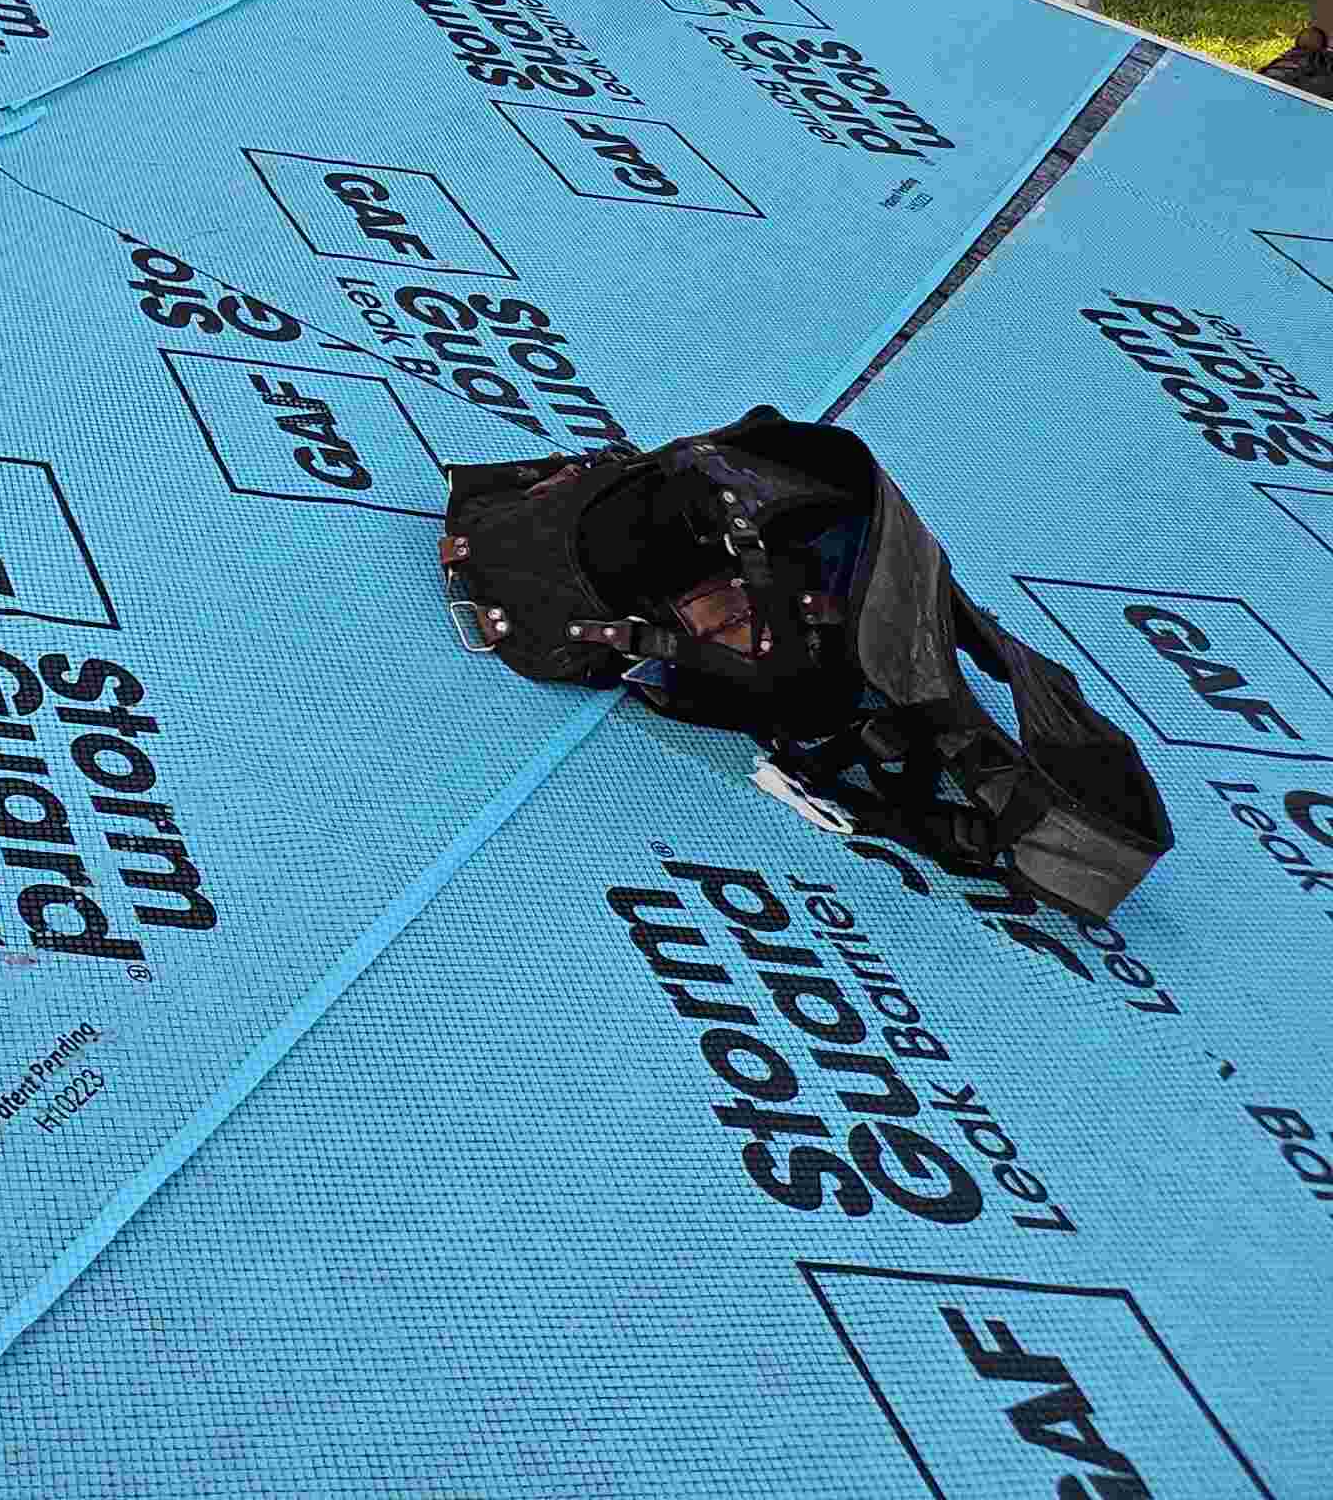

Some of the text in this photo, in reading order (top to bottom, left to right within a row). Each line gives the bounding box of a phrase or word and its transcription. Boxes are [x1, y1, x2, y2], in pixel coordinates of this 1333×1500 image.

[574, 56, 646, 106] Leak
[695, 26, 851, 149] Leak Barrier
[796, 39, 955, 148] Storm
[564, 115, 679, 196] GAF
[324, 172, 434, 261] GAF
[336, 276, 416, 348] Leak
[1192, 309, 1320, 401] Barrier
[249, 374, 372, 491] GAF
[1080, 309, 1289, 466] Storm
[1123, 605, 1302, 741] GAF
[38, 653, 218, 932] Storm
[788, 874, 951, 1062] Barrier
[32, 1021, 99, 1084] Pending
[33, 1066, 106, 1134] H10223
[606, 886, 874, 1217] Storm
[929, 1079, 1077, 1234] Leak
